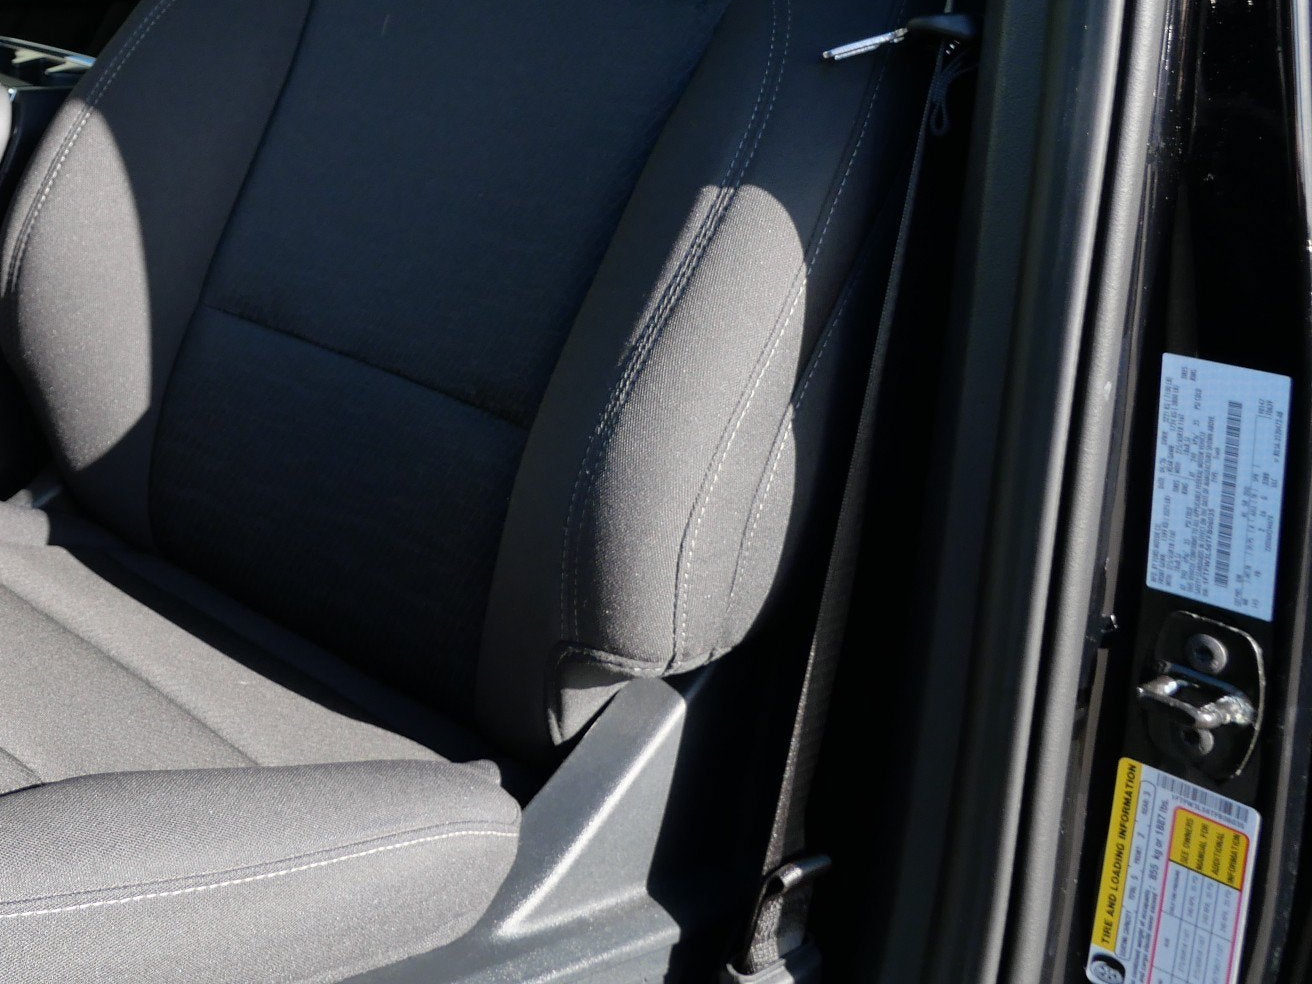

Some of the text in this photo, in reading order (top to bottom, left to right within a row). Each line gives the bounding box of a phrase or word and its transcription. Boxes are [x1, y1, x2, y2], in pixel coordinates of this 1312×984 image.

[1154, 812, 1166, 836] 1887
[1100, 762, 1137, 945] TIRE AND LOADING INFORMATION
[1150, 846, 1163, 861] kg
[1154, 837, 1162, 848] or
[1194, 821, 1209, 871] MANUAL FOR
[1210, 830, 1224, 876] ADDITIONAL
[1225, 831, 1240, 885] INFORMATION
[1147, 862, 1159, 881] 855
